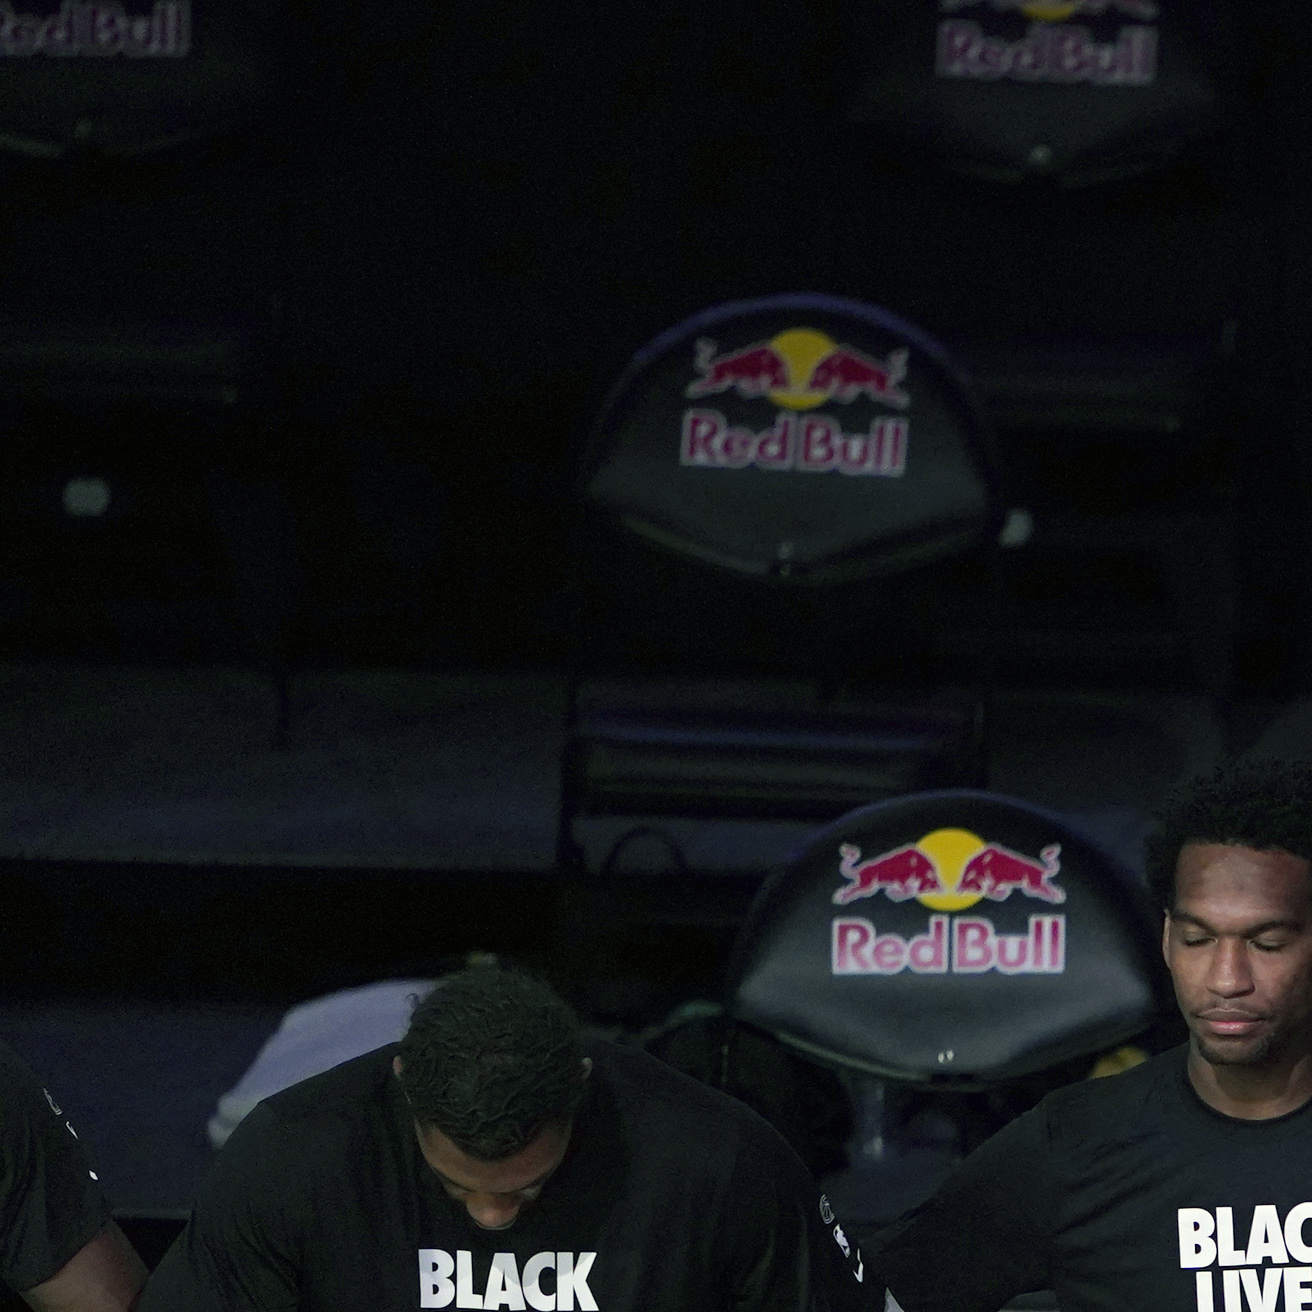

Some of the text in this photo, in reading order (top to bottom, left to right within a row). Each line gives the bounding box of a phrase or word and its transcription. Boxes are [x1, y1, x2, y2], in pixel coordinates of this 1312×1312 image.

[0, 0, 81, 57] ed
[936, 18, 1159, 86] Red Bull
[680, 408, 909, 478] Red Bull
[832, 914, 1066, 975] Red Bull
[418, 1249, 599, 1312] BLACK
